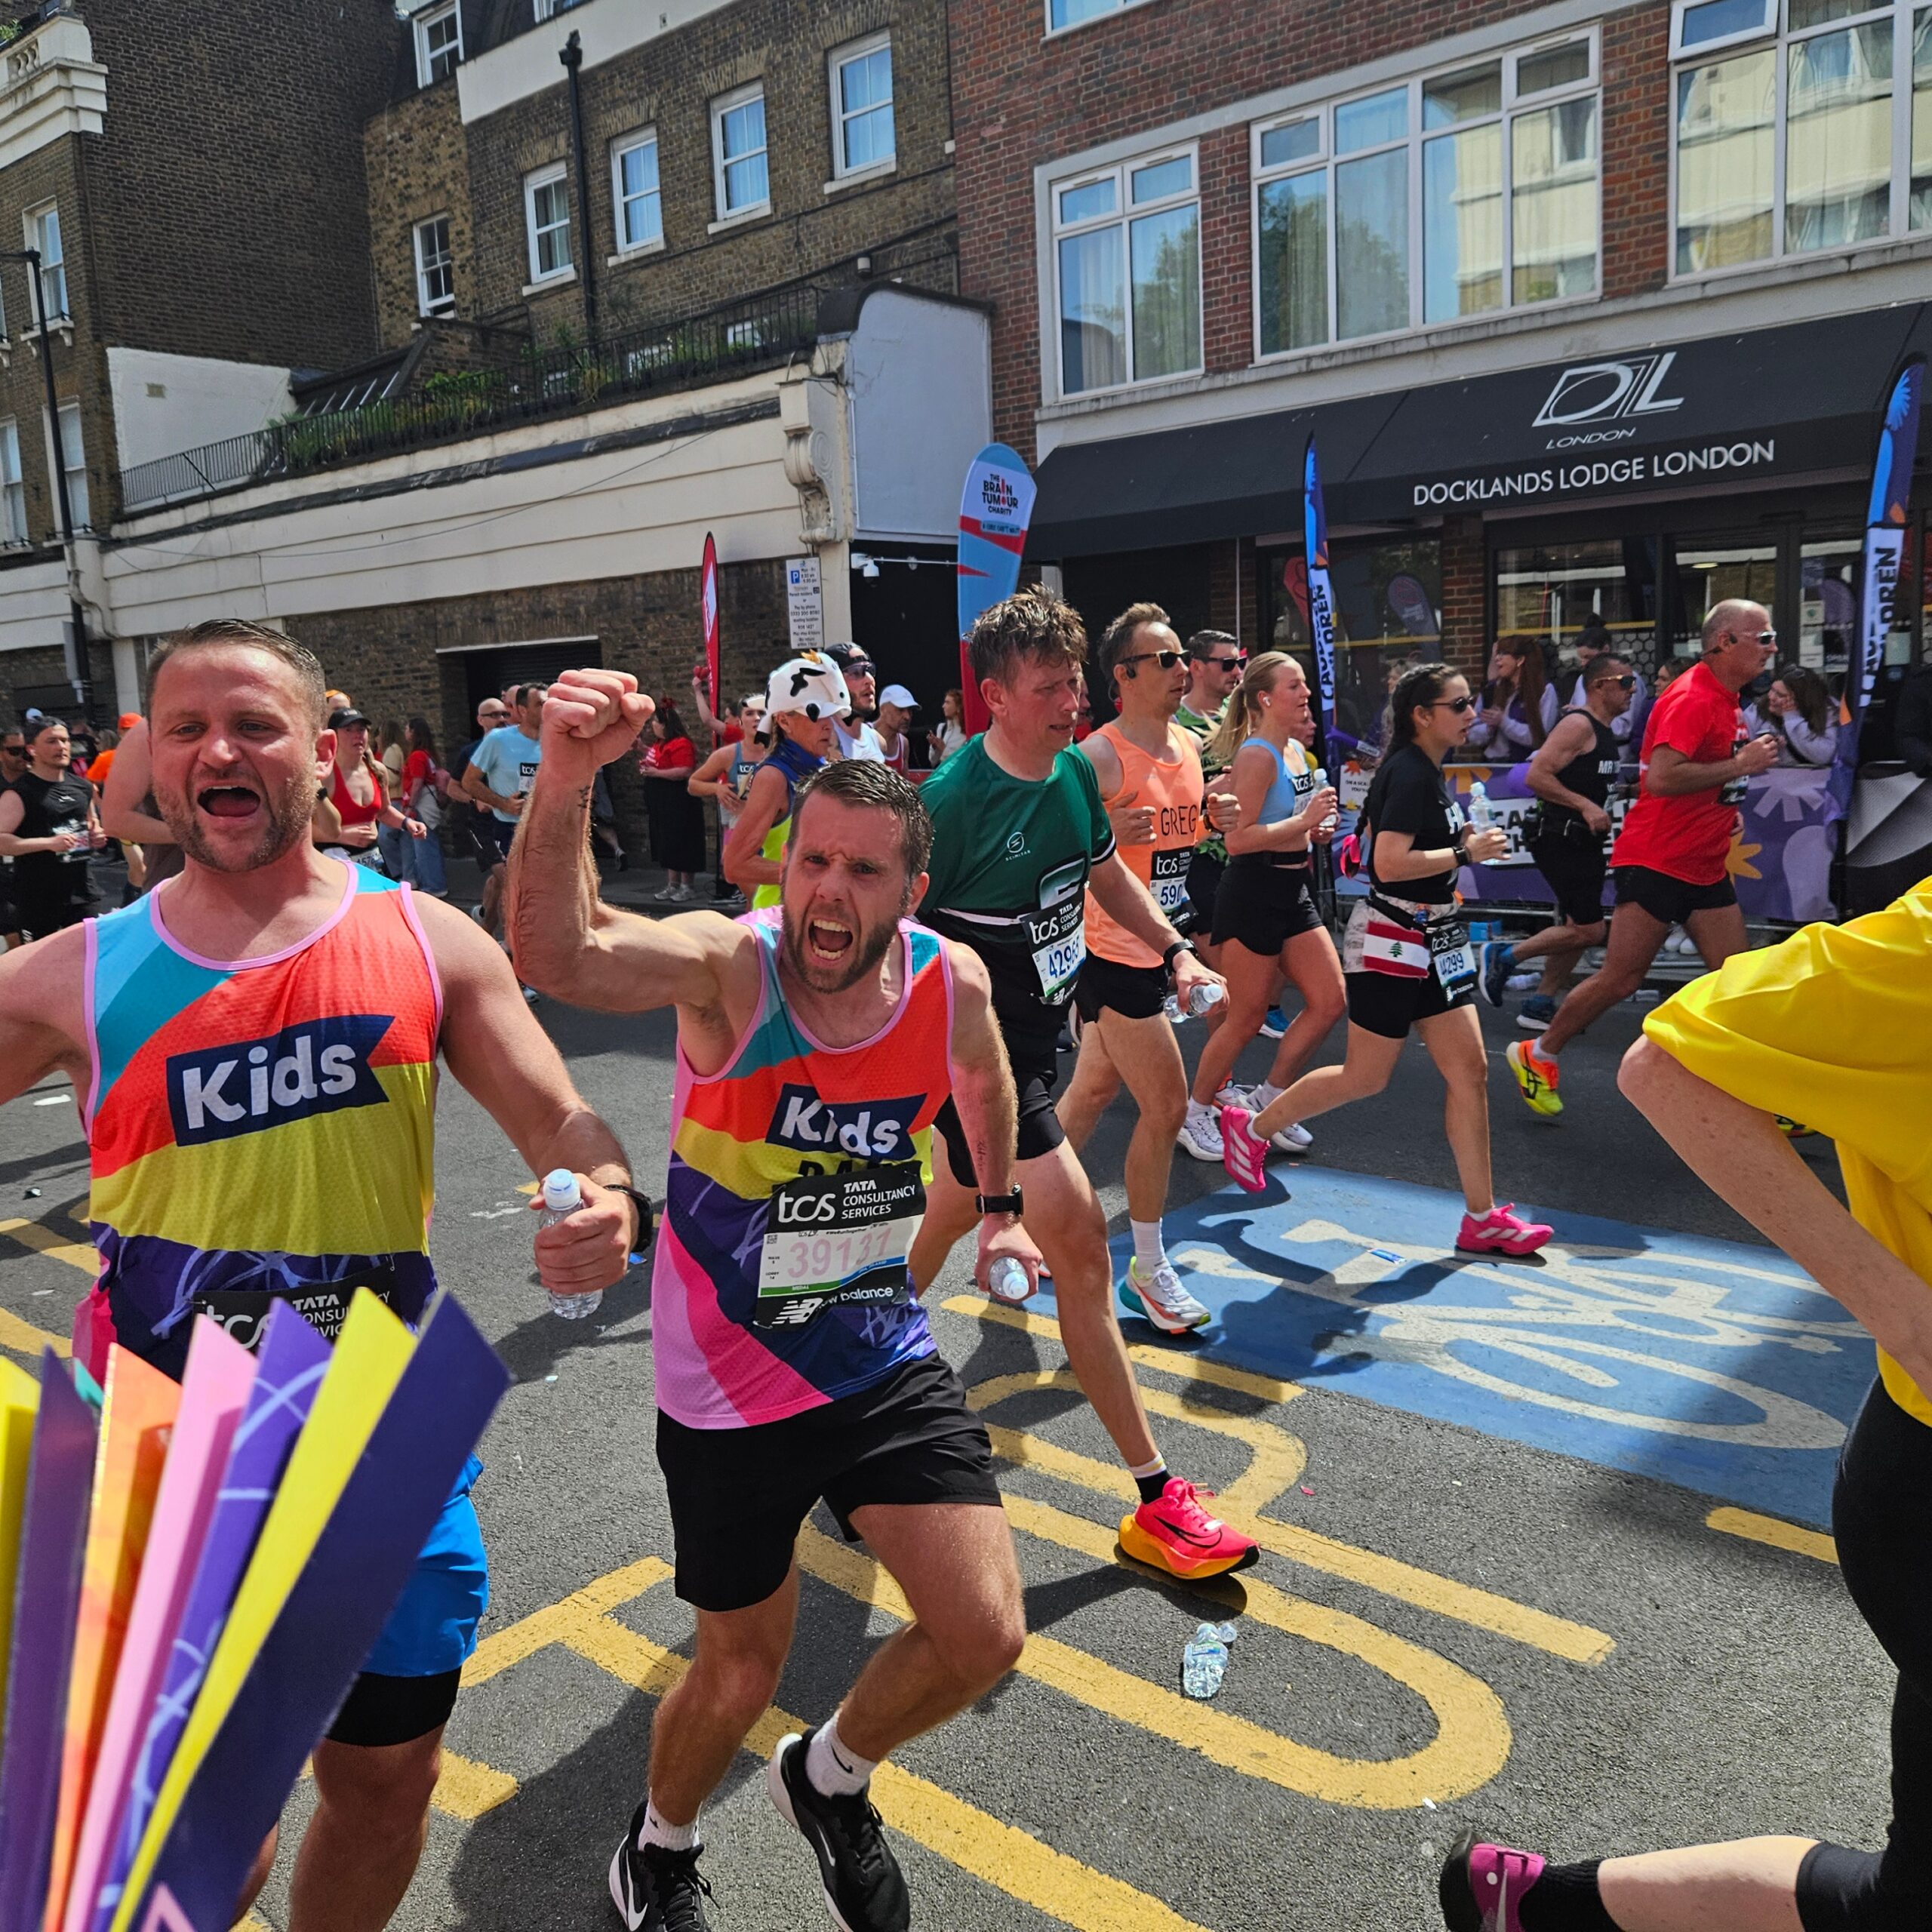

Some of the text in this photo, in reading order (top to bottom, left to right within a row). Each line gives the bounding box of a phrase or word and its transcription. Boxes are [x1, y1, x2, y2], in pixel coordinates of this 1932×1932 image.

[1545, 427, 1637, 451] LONDON
[989, 473, 1000, 483] THE
[1414, 439, 1775, 506] DOCKLANDS LODGE LONDON
[983, 478, 1013, 497] BRAIN
[982, 491, 1019, 509] TUMOUR
[988, 506, 1012, 516] CHARITY
[1160, 804, 1198, 836] GREG
[1156, 856, 1178, 875] tcs
[1060, 903, 1073, 915] TATA
[1029, 916, 1059, 945] tcs
[183, 1035, 357, 1130] Kids
[780, 1096, 901, 1156] Kids
[842, 1184, 916, 1208] CONSULTANCY
[844, 1180, 877, 1193] TATA
[778, 1191, 836, 1223] tcs
[841, 1203, 892, 1220] SERVICES
[292, 1294, 340, 1312] TATA
[840, 1286, 894, 1301] balance
